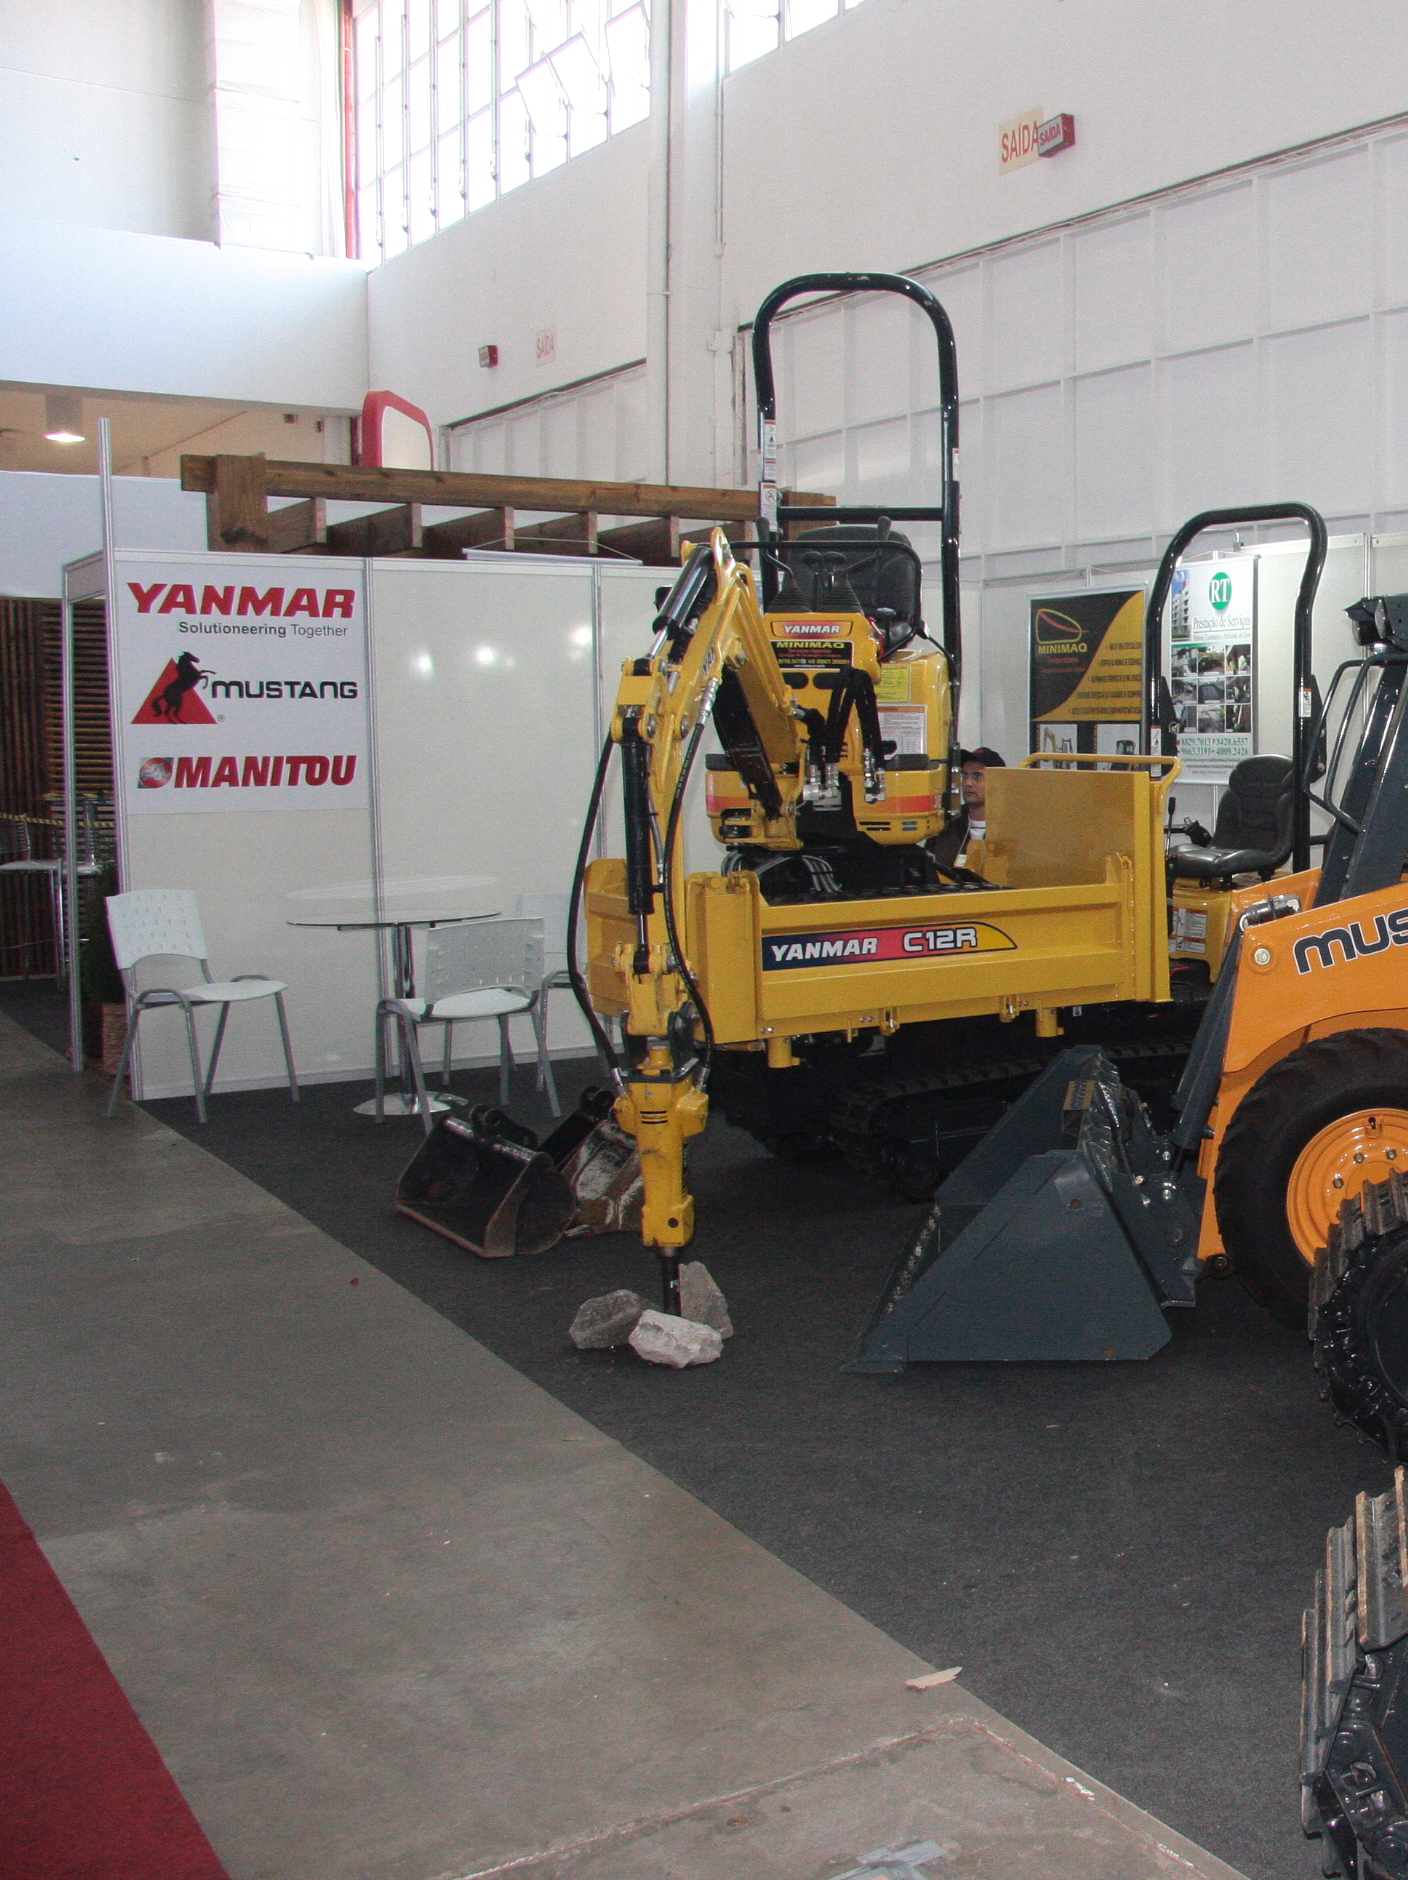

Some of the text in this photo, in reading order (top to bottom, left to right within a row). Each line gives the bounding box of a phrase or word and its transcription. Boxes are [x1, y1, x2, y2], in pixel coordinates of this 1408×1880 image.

[127, 582, 355, 618] YANMAR
[1211, 578, 1230, 604] RT
[179, 621, 348, 638] Solutioneering Together
[784, 625, 840, 634] YANMAR
[1037, 643, 1088, 654] MINIMAQ
[211, 681, 358, 699] MUSTANG
[174, 755, 357, 788] MANITOU
[771, 927, 977, 962] YANMAR C12R
